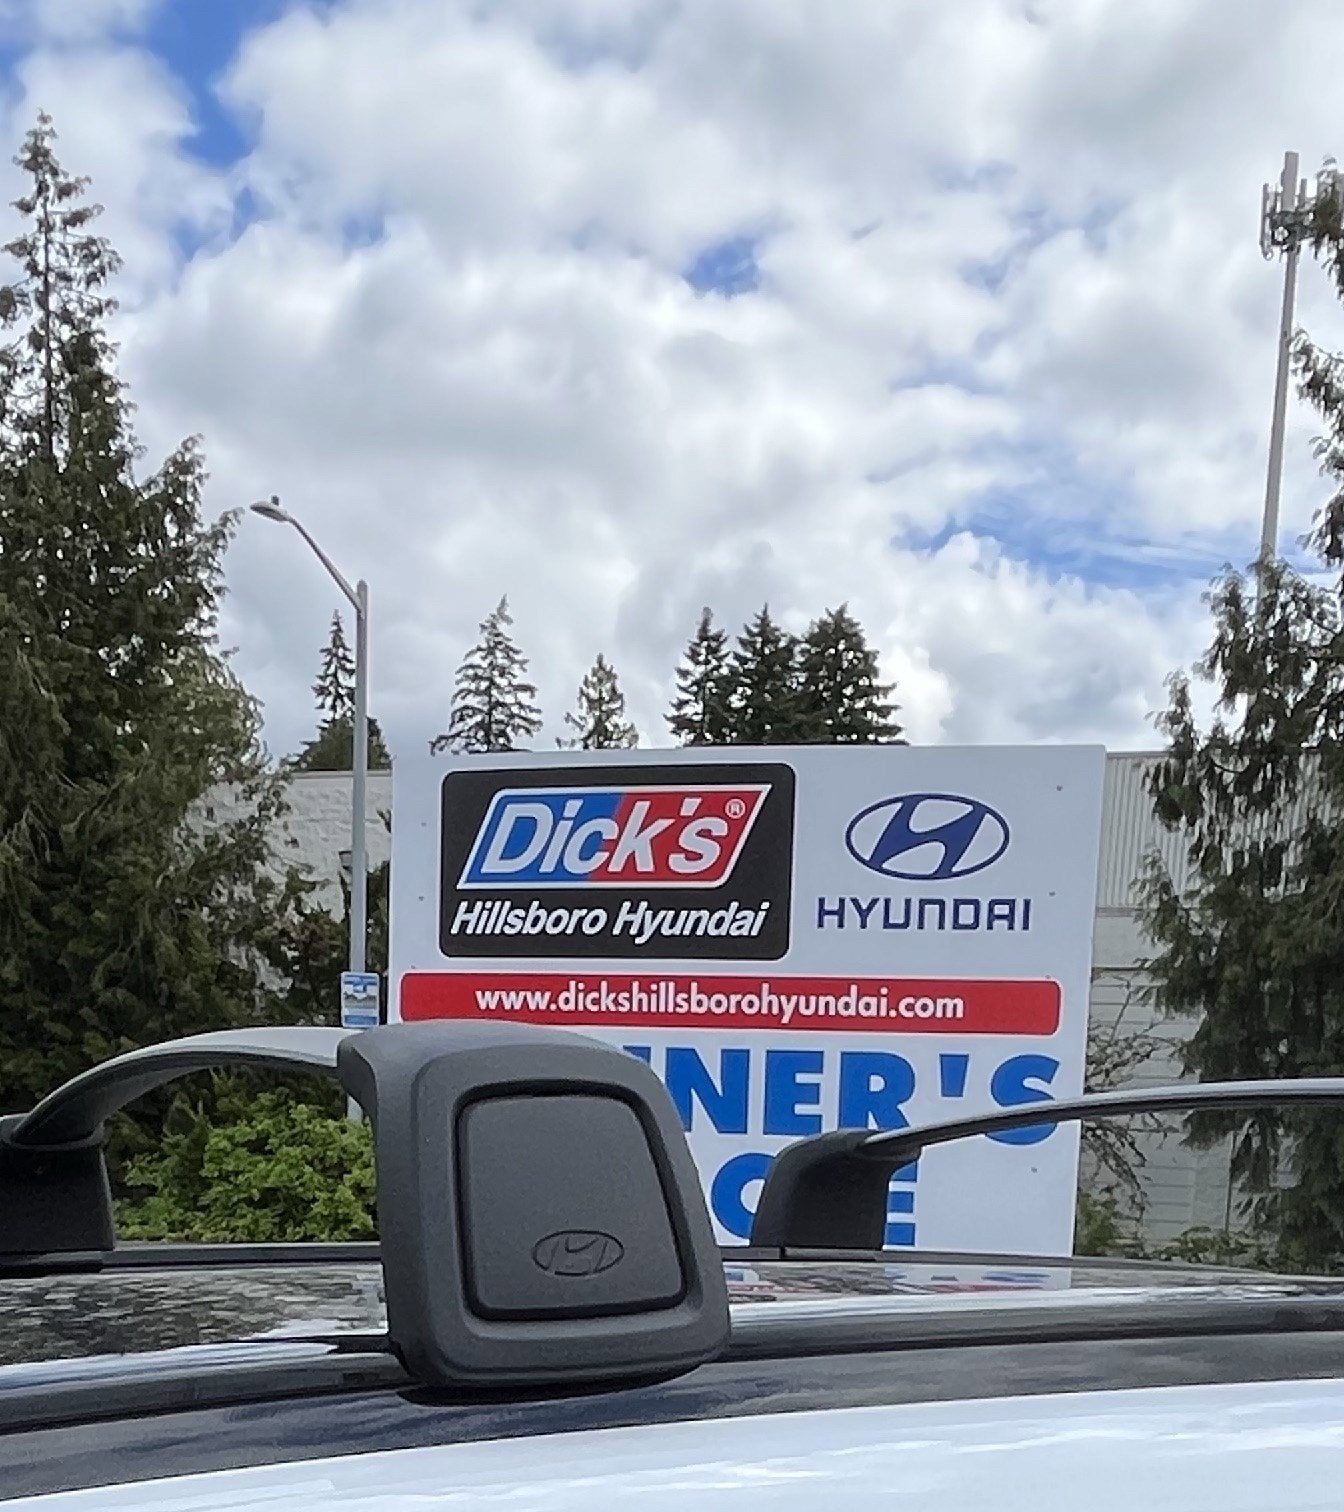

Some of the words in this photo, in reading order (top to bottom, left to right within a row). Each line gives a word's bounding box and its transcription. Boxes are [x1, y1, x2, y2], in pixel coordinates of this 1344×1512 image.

[480, 797, 729, 875] Dick's
[450, 900, 608, 936] Hillsboro
[612, 901, 771, 945] Hyundai
[816, 897, 1032, 931] HYUNDAI
[474, 980, 965, 1024] www.dickshillsborohyundai.com
[623, 1045, 1060, 1146] NER'S
